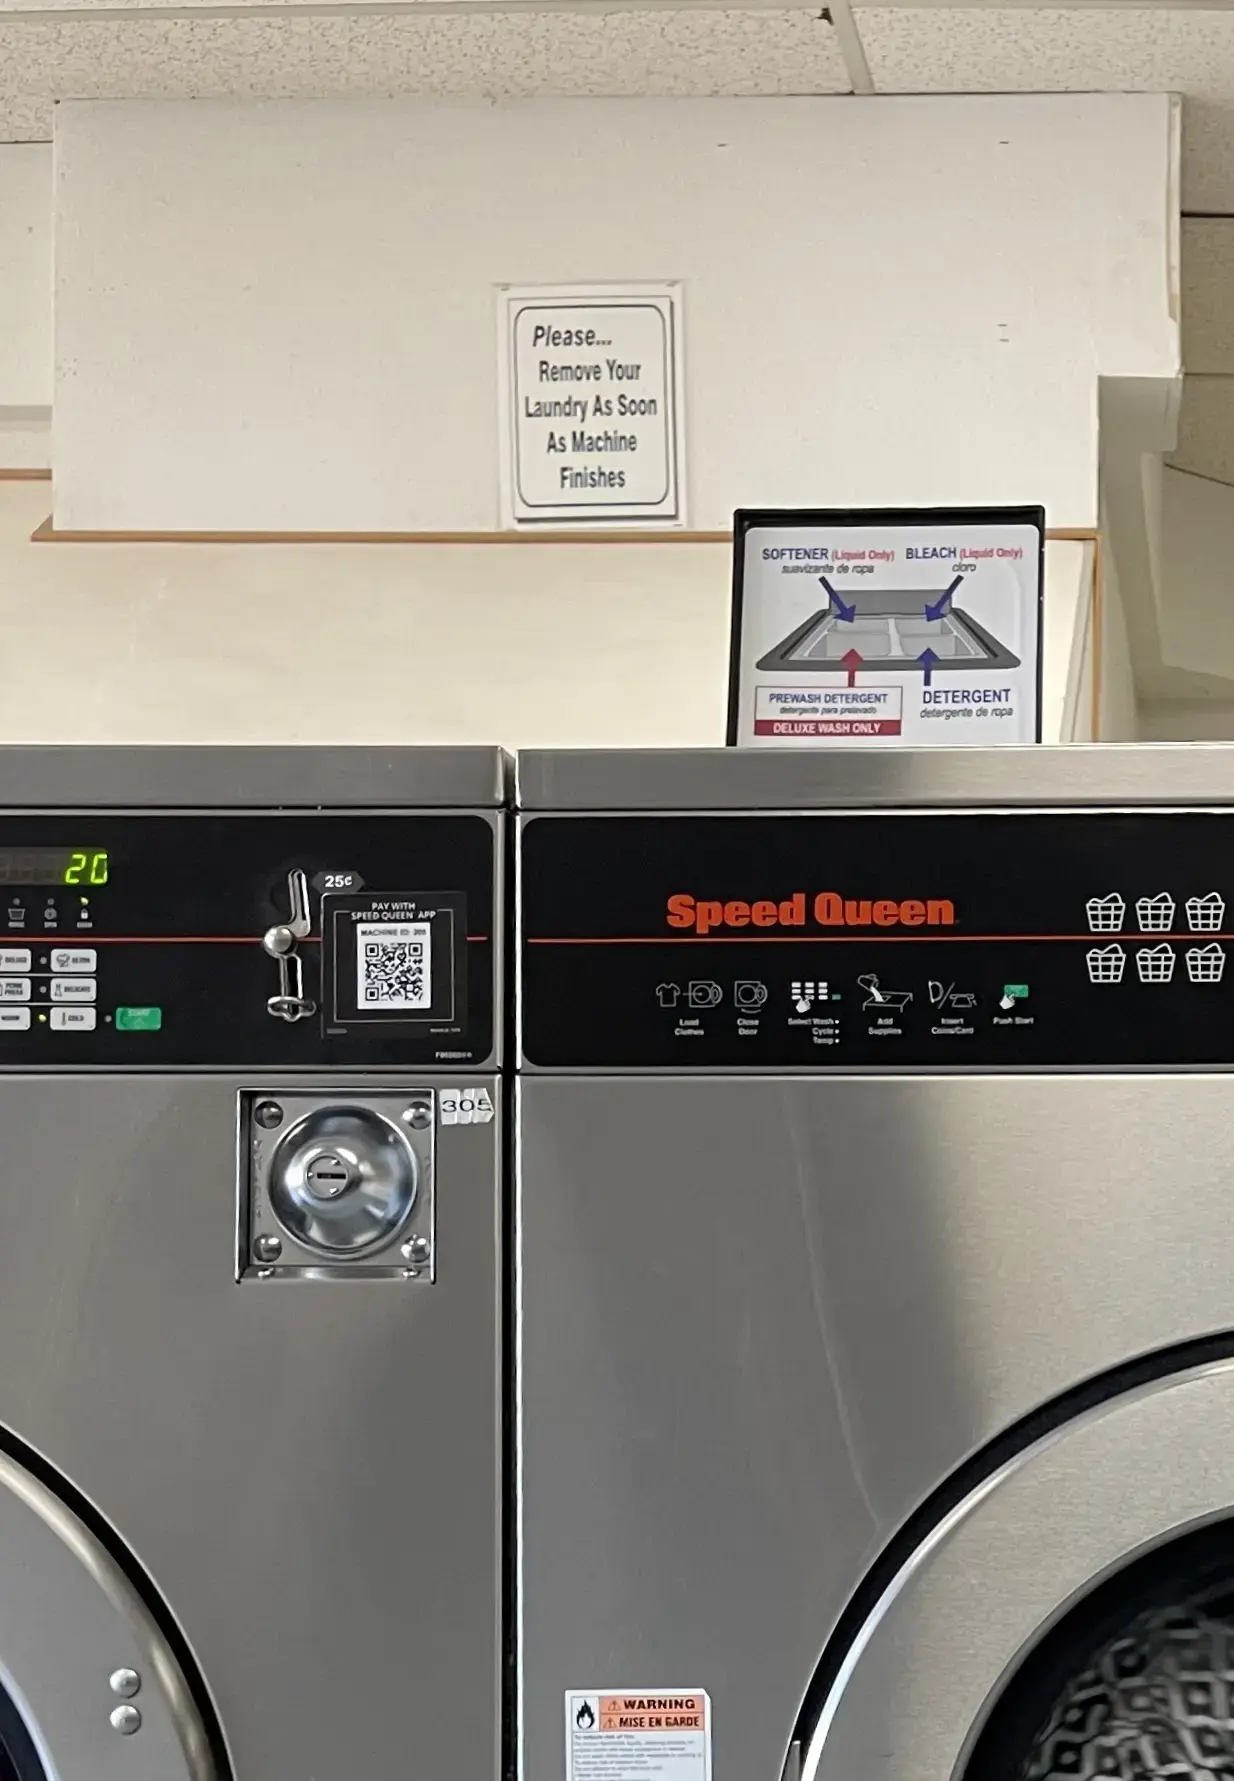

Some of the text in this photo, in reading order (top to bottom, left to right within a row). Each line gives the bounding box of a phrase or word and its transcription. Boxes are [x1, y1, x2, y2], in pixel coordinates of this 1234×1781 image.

[532, 325, 612, 347] Please...
[539, 358, 641, 382] Remove Your
[525, 393, 657, 423] Laundry As Soon
[546, 430, 637, 453] As Machine
[560, 466, 626, 489] Finishes
[762, 548, 829, 561] SOFTENER
[868, 548, 895, 563] Only)
[905, 547, 957, 560] BLEACH
[996, 547, 1023, 560] Only)
[837, 563, 849, 574] de
[852, 565, 875, 575] ropa
[769, 693, 888, 705] PREWASH DETERGENT
[923, 689, 1011, 704] DETERGENT
[920, 707, 1013, 720] detergente de ropa
[773, 722, 882, 735] DELUXE WASH ONLY
[65, 854, 108, 884] 20
[371, 902, 416, 911] PAY WITH
[666, 892, 955, 934] Speed Queen
[351, 911, 437, 920] SPEED QUEEN APP
[442, 1099, 492, 1112] 305
[623, 1699, 695, 1710] WARNING
[619, 1716, 700, 1727] MISE EN GARDE
